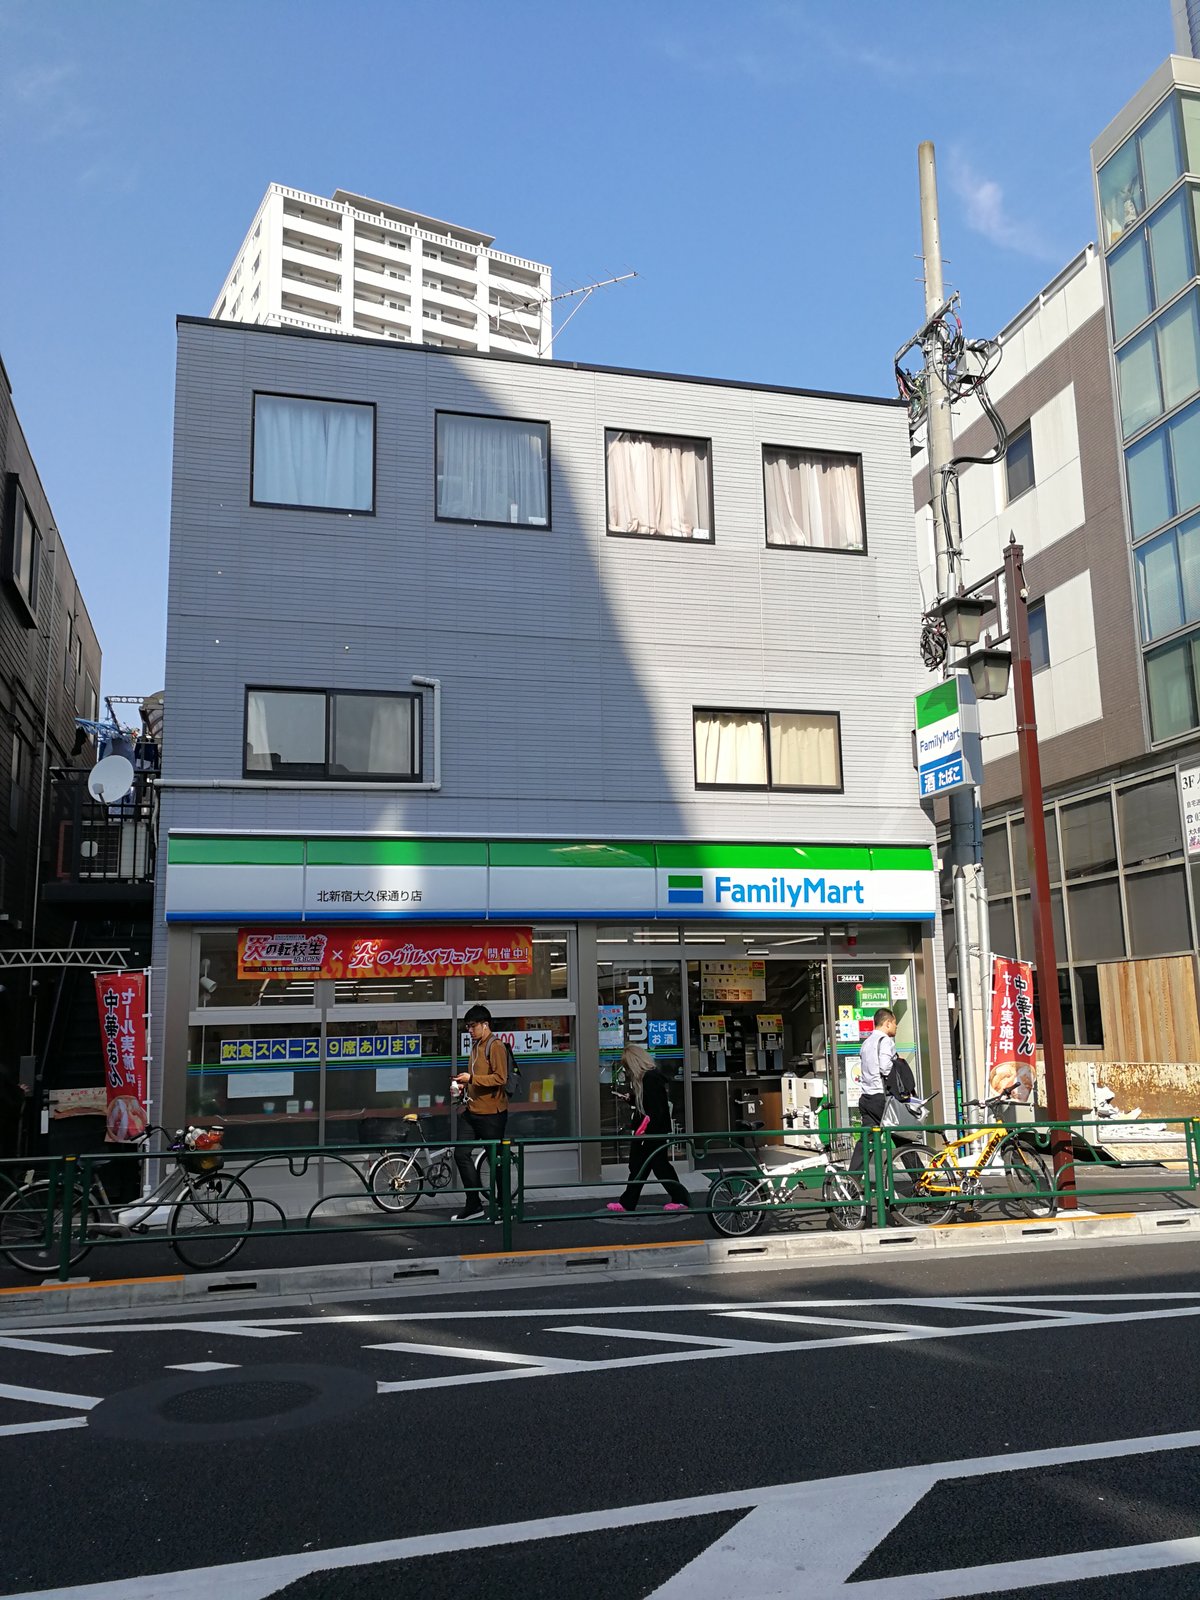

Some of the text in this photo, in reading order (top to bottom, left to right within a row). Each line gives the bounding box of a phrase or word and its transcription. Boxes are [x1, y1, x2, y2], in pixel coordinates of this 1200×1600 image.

[920, 727, 961, 752] FamilyMart
[924, 766, 960, 792] 酒 たばこ
[1182, 773, 1194, 790] 3F
[317, 890, 422, 902] 北新宿大久保通り店
[715, 877, 865, 907] FamilyMart
[999, 971, 1014, 1054] セール実施中
[1014, 975, 1034, 1055] 中華まん
[649, 1022, 677, 1033] たばこ
[222, 1038, 419, 1059] 飲食スペース 9席あります
[525, 1033, 549, 1049] セール
[652, 1034, 674, 1045] お酒
